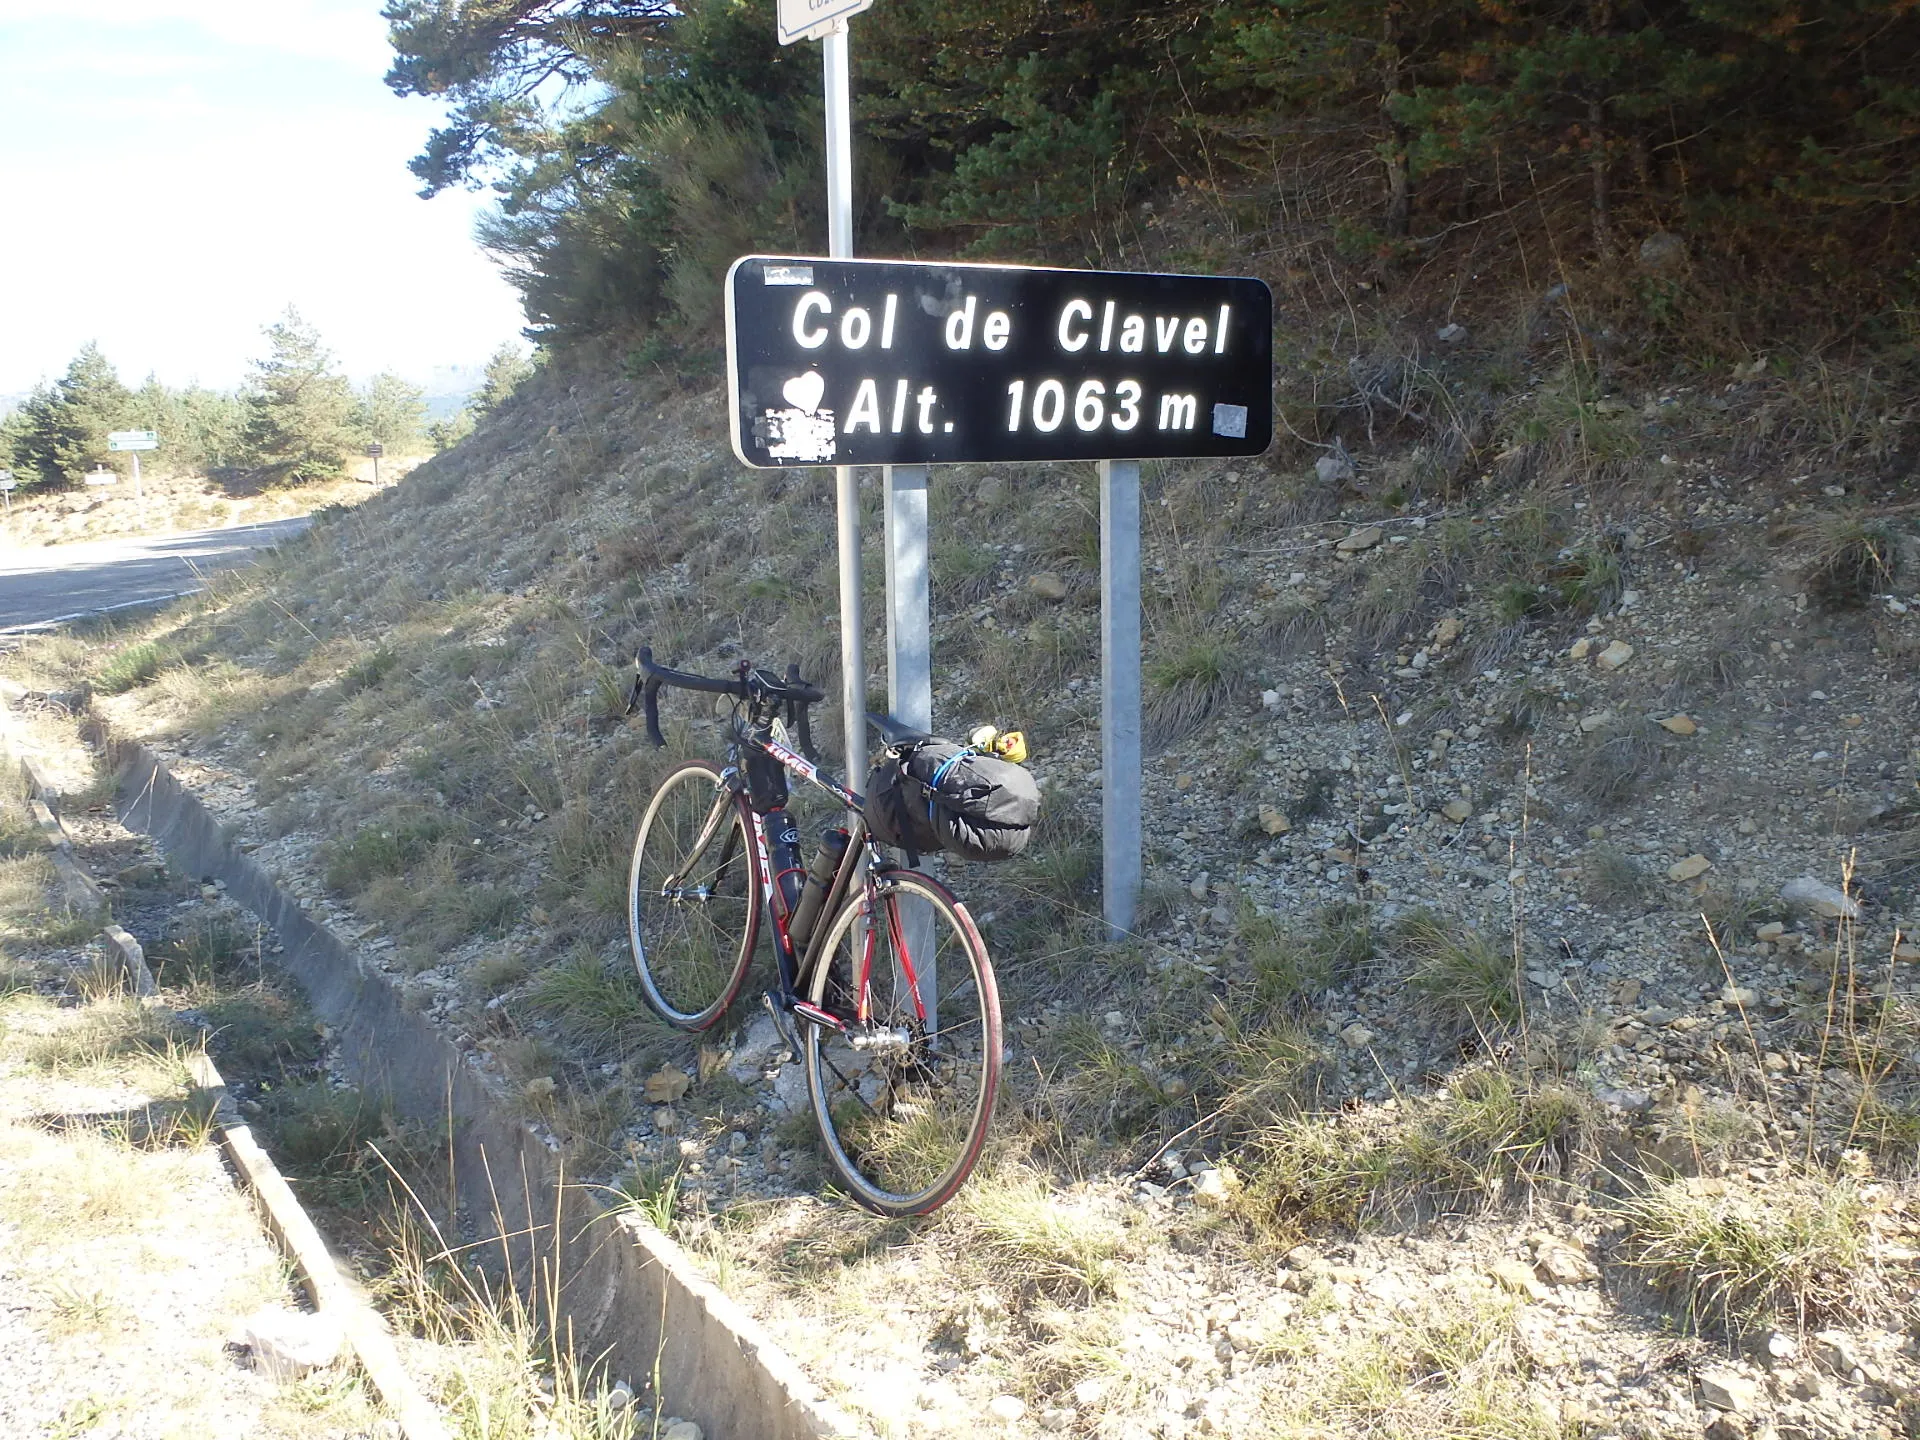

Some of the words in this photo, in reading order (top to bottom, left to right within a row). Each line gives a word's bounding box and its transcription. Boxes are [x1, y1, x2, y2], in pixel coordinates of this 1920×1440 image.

[791, 288, 899, 352] Col
[944, 294, 1011, 353] de
[1057, 298, 1230, 355] Clavel
[842, 377, 955, 435] Alt.
[1007, 378, 1143, 434] 1063
[1158, 393, 1197, 432] m
[766, 742, 811, 777] TIME
